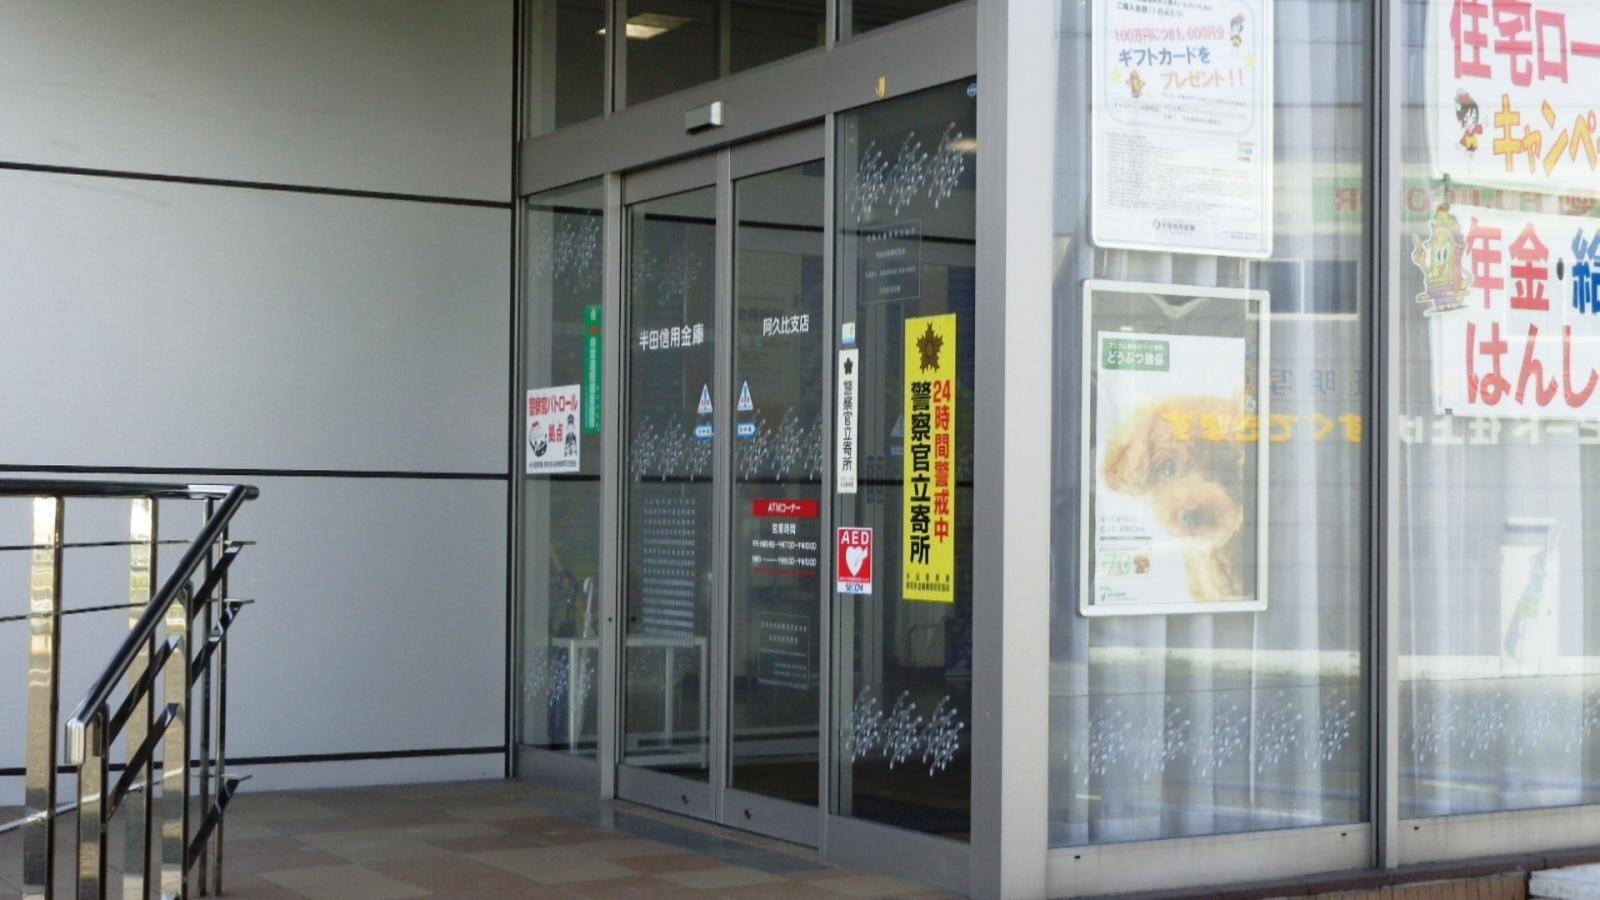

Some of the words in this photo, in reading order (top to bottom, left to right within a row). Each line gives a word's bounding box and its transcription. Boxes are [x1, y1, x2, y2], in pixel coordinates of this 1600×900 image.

[1118, 46, 1211, 67] ギフトカードを
[1493, 93, 1600, 176] キャンペ
[639, 323, 705, 351] 半田信用金庫
[763, 314, 809, 336] 阿久比支店
[1466, 322, 1600, 408] はんし
[910, 381, 931, 565] 警察官立寄所
[933, 379, 951, 543] 24時間警戒中
[841, 531, 870, 545] AED
